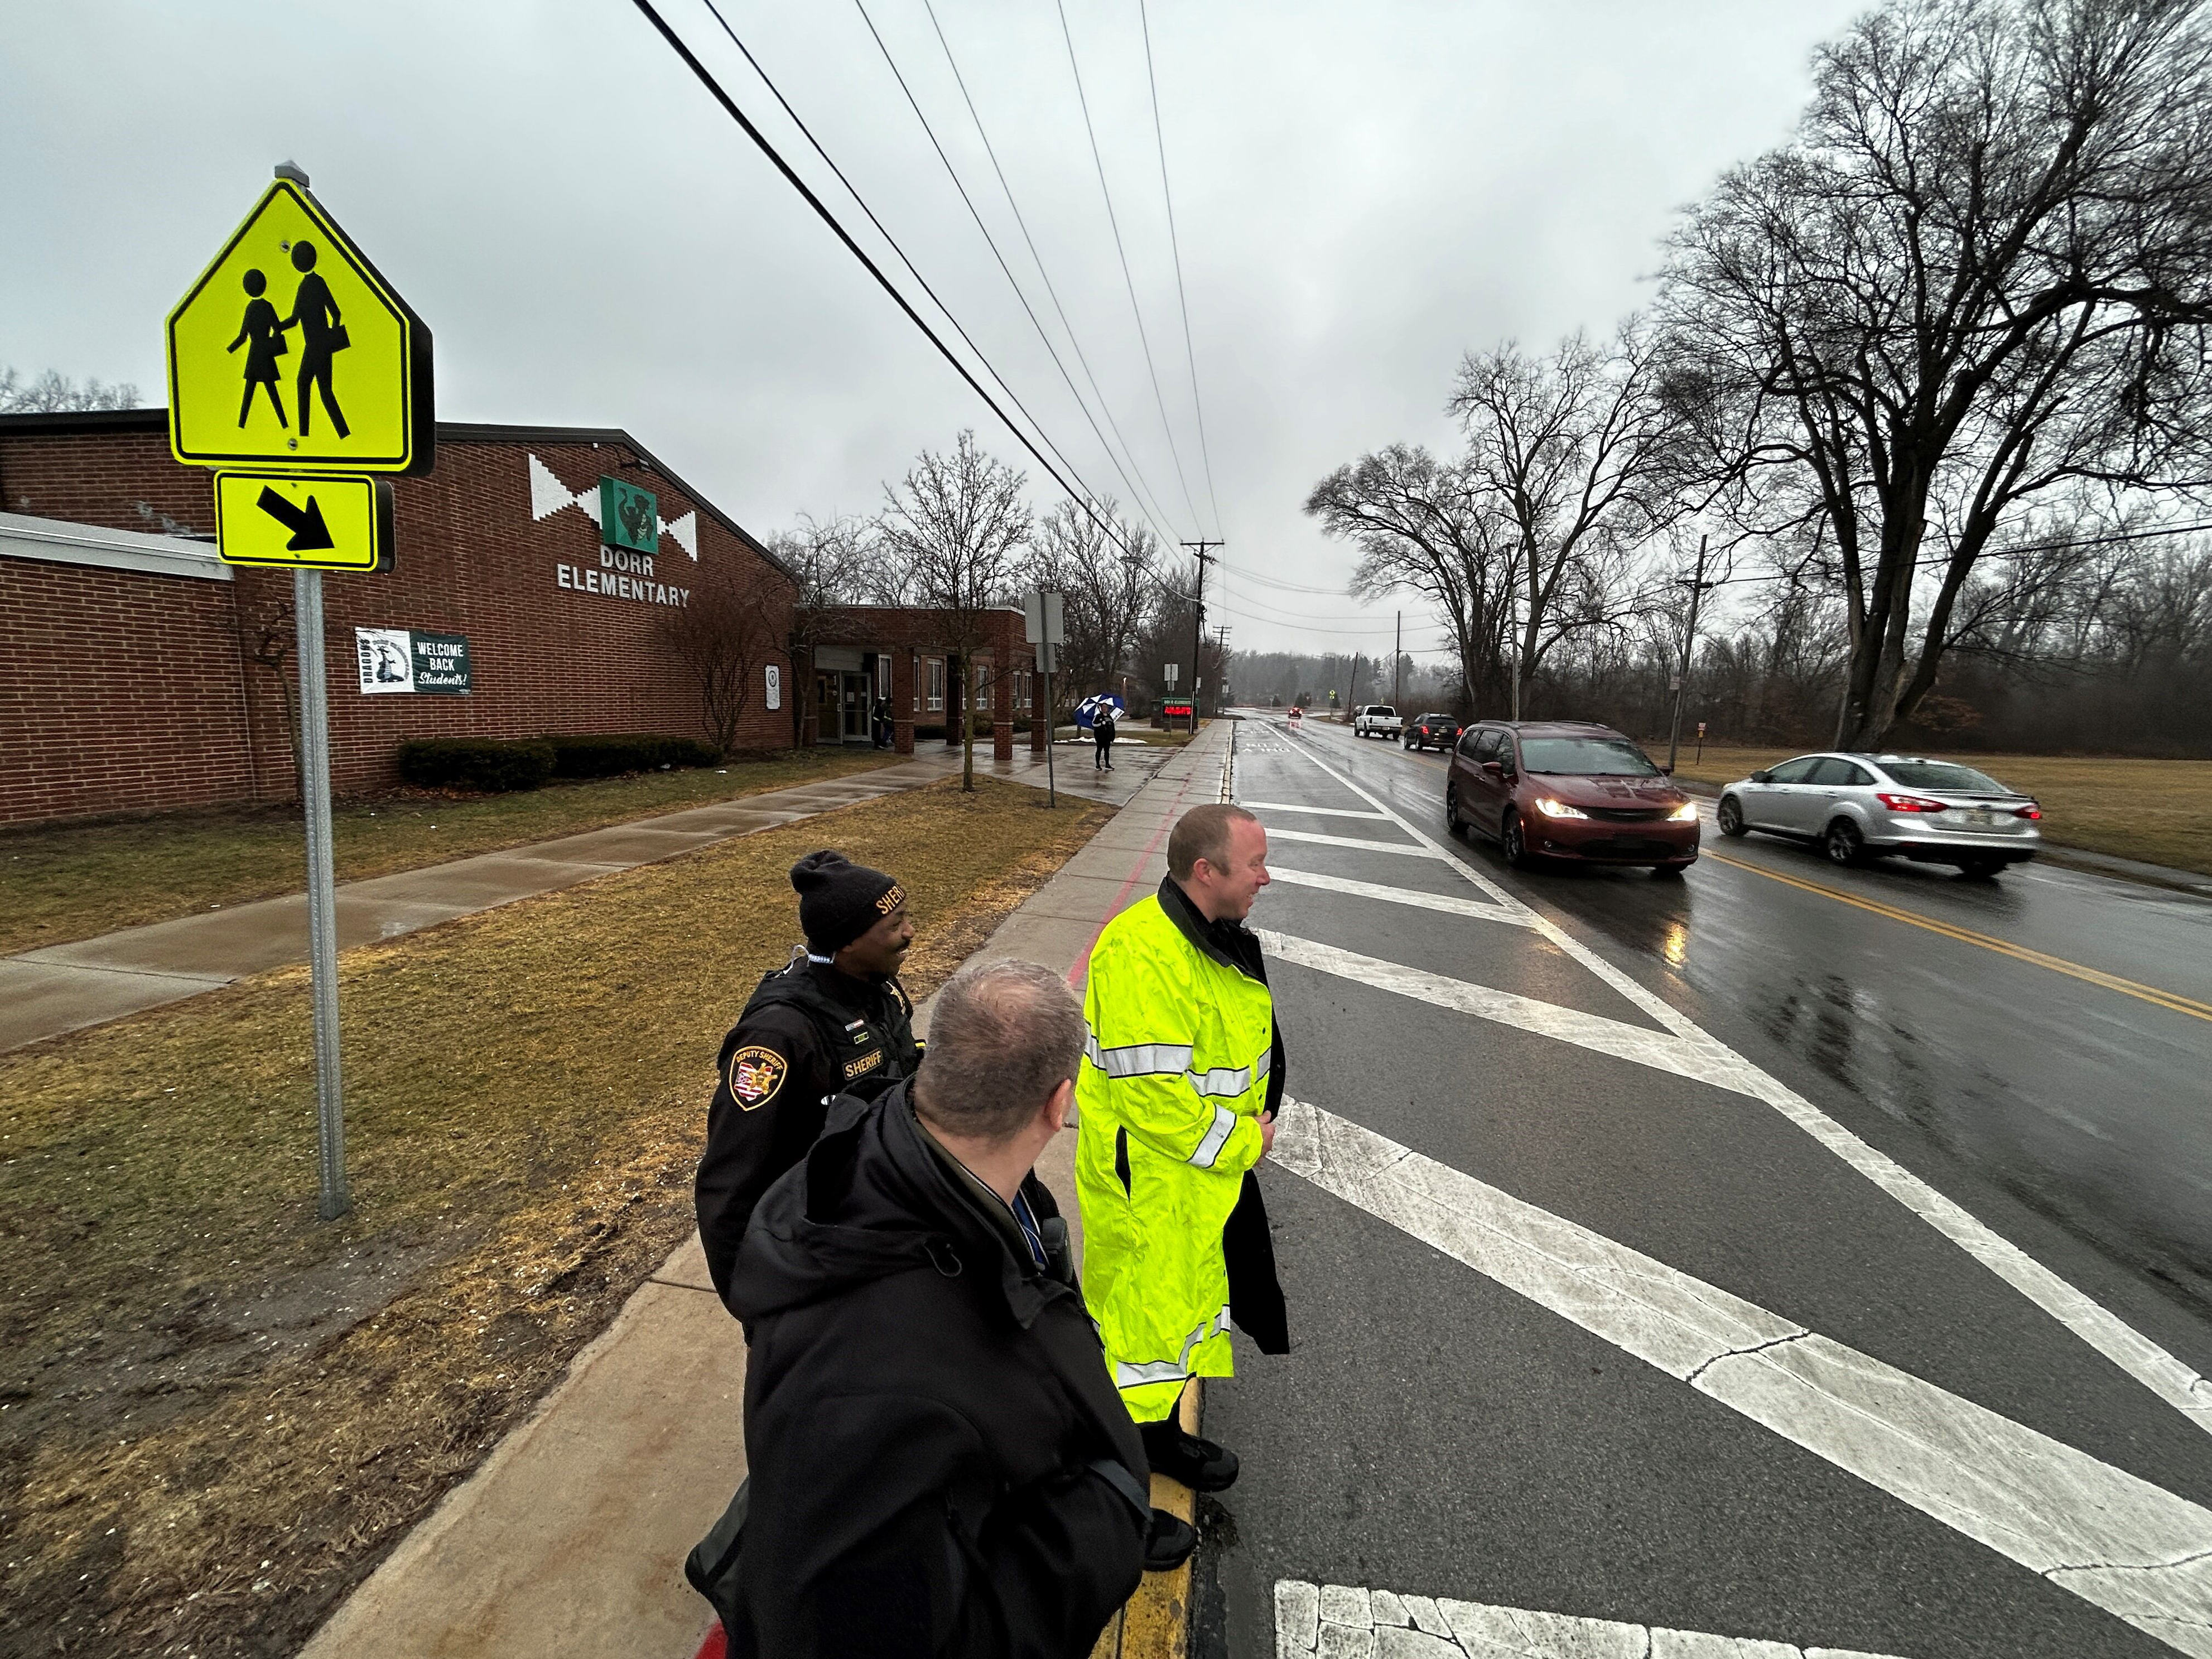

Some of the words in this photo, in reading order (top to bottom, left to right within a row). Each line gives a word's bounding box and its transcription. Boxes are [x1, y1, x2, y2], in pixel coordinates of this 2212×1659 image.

[600, 544, 653, 577] DORR
[557, 563, 690, 608] ELEMENTARY
[417, 642, 464, 657] WELCOME
[429, 658, 455, 671] BACK
[418, 672, 467, 686] Students!
[736, 1050, 759, 1063] DEPUTY
[759, 1052, 783, 1070] SHERIFF
[845, 1050, 881, 1077] SHERIFF
